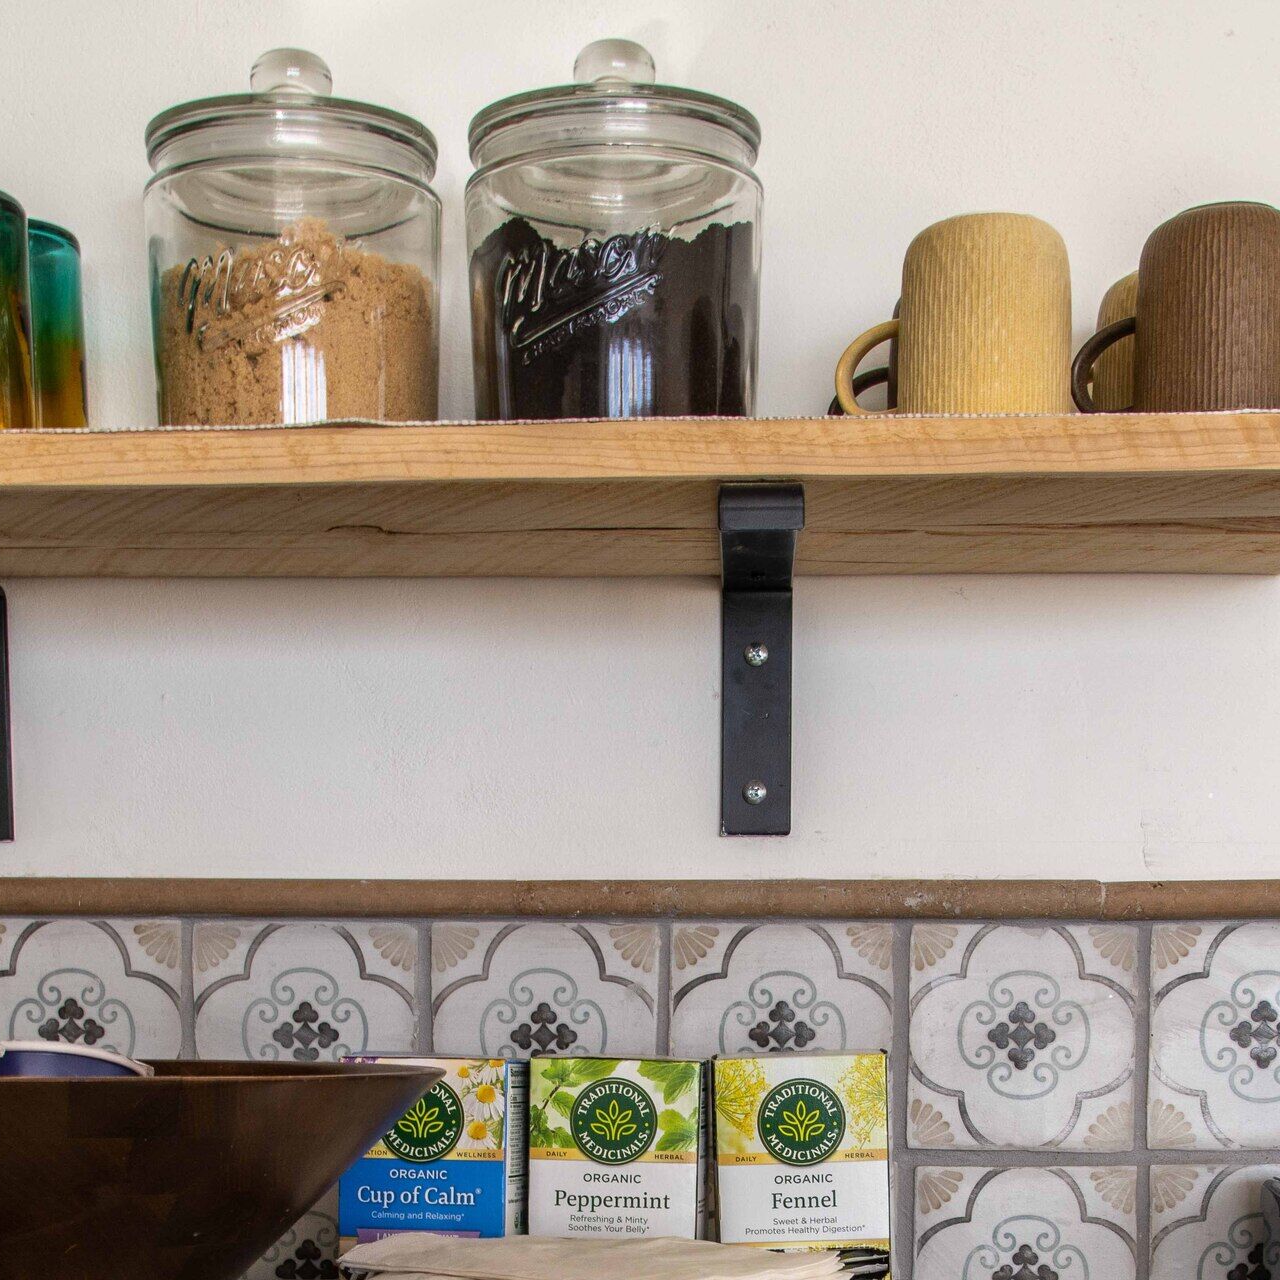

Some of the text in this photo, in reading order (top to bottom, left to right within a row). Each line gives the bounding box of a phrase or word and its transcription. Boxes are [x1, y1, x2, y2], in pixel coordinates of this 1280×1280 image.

[577, 1084, 650, 1118] TRADITIONAL
[764, 1084, 838, 1118] TRADITIONAL
[386, 1129, 455, 1158] MEDICINALS
[579, 1131, 648, 1160] MEDICINALS
[767, 1131, 837, 1161] MEDICINALS
[389, 1169, 448, 1180] ORGANIC
[583, 1173, 641, 1184] ORGANIC
[774, 1173, 833, 1185] ORGANIC
[357, 1185, 395, 1209] Cup
[400, 1186, 421, 1204] of
[554, 1189, 670, 1213] Peppermint
[772, 1190, 838, 1210] Fennel
[371, 1211, 405, 1221] Calming
[407, 1211, 423, 1220] and
[570, 1215, 614, 1224] Refreshing
[625, 1215, 648, 1225] Minty
[773, 1216, 838, 1226] Sweet & Herbal
[568, 1224, 602, 1232] Soothes
[604, 1225, 623, 1233] Your
[745, 1227, 785, 1236] Promotes
[788, 1226, 820, 1235] Healthy
